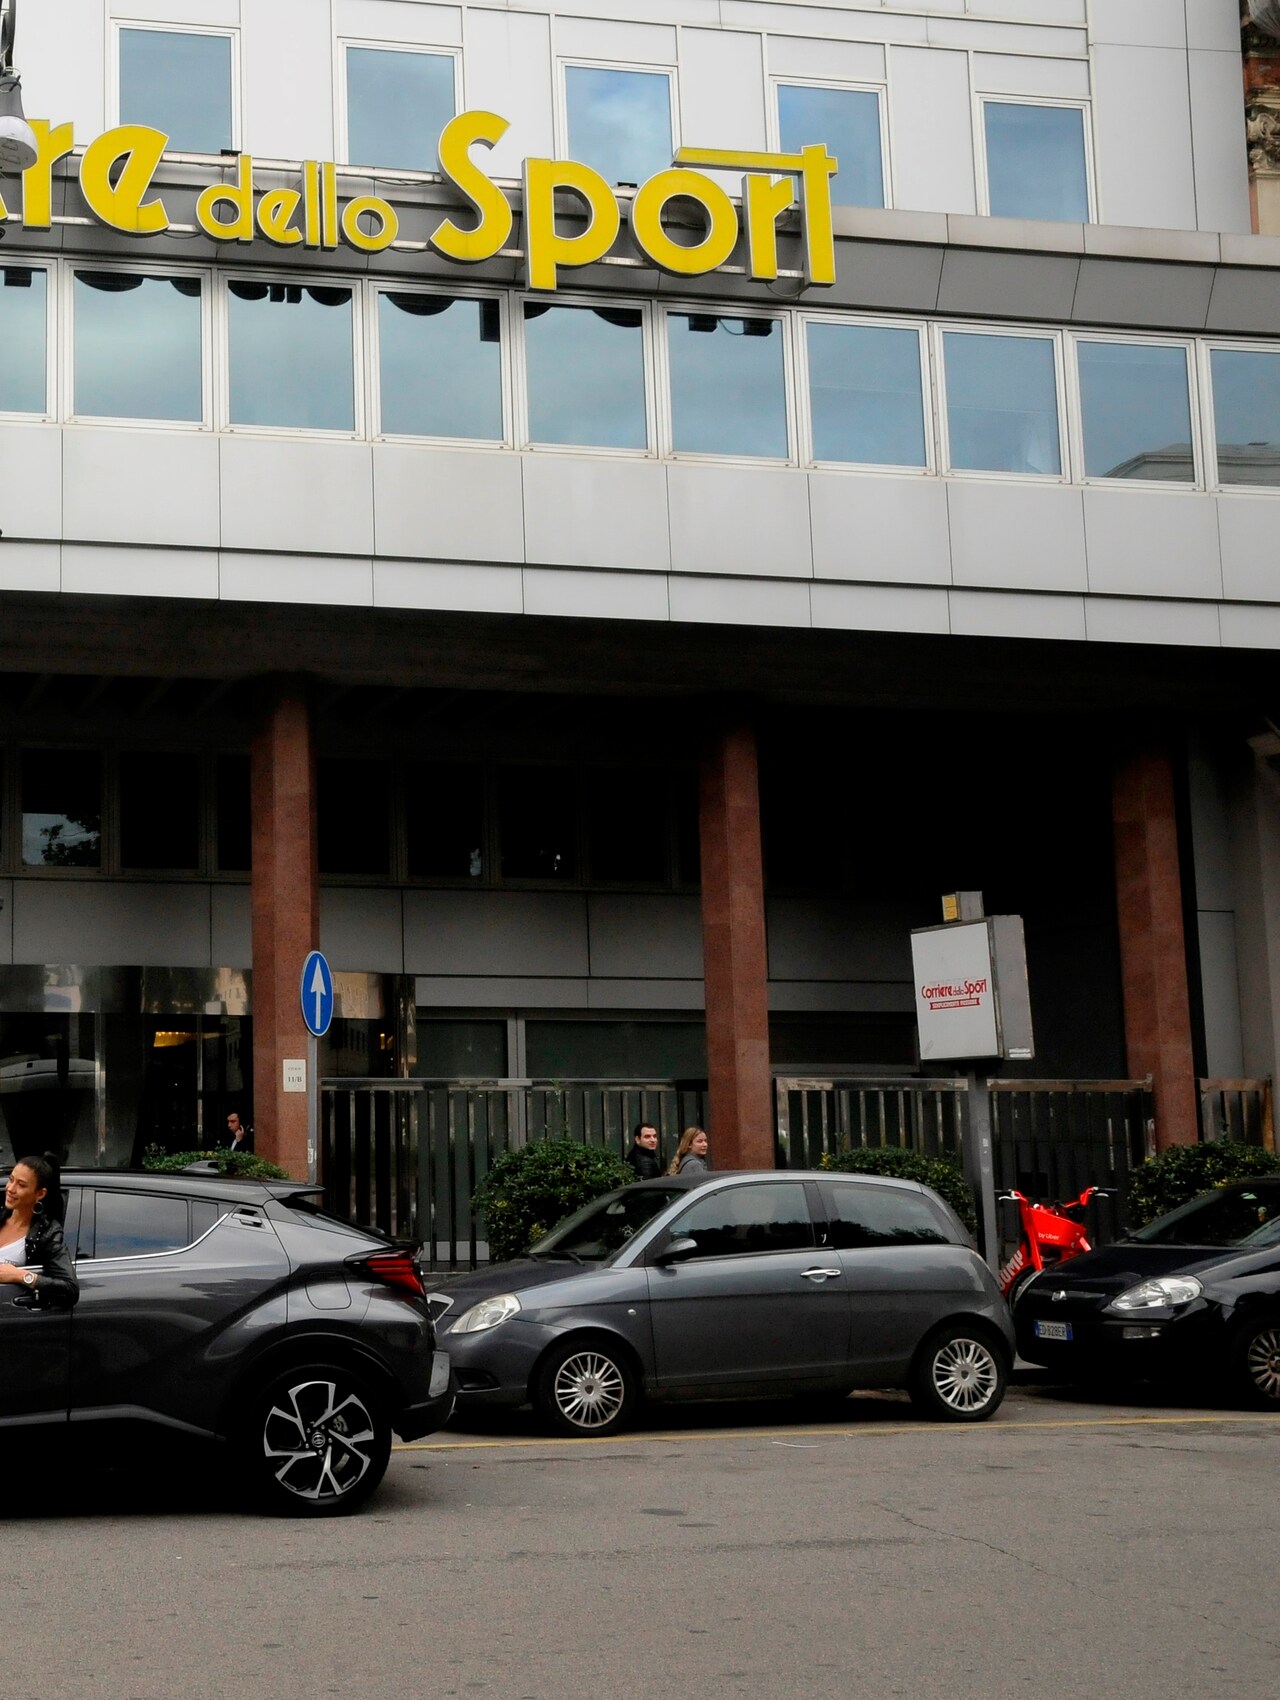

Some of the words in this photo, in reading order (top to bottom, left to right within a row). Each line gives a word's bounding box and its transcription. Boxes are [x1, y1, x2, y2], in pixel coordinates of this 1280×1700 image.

[196, 153, 399, 252] dello
[428, 110, 839, 291] Sport
[921, 984, 953, 999] Corriere
[964, 979, 987, 999] Sport
[998, 1249, 1024, 1290] JUMP
